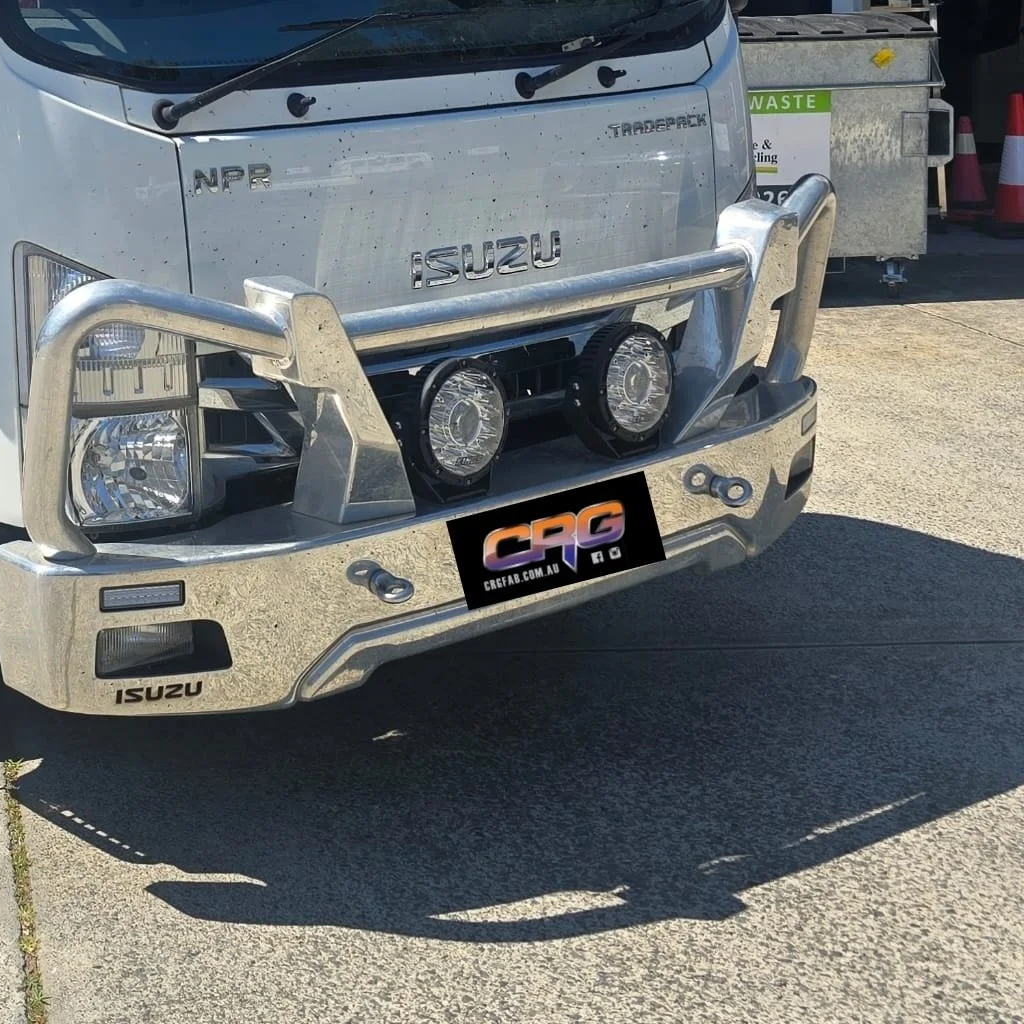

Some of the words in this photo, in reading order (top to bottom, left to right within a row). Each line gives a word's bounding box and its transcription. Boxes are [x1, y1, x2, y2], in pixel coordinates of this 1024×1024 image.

[749, 94, 816, 110] WASTE
[608, 113, 708, 138] TRADEPACK
[193, 163, 272, 195] NPR
[410, 230, 561, 290] ISUZU
[115, 680, 203, 704] ISUZU
